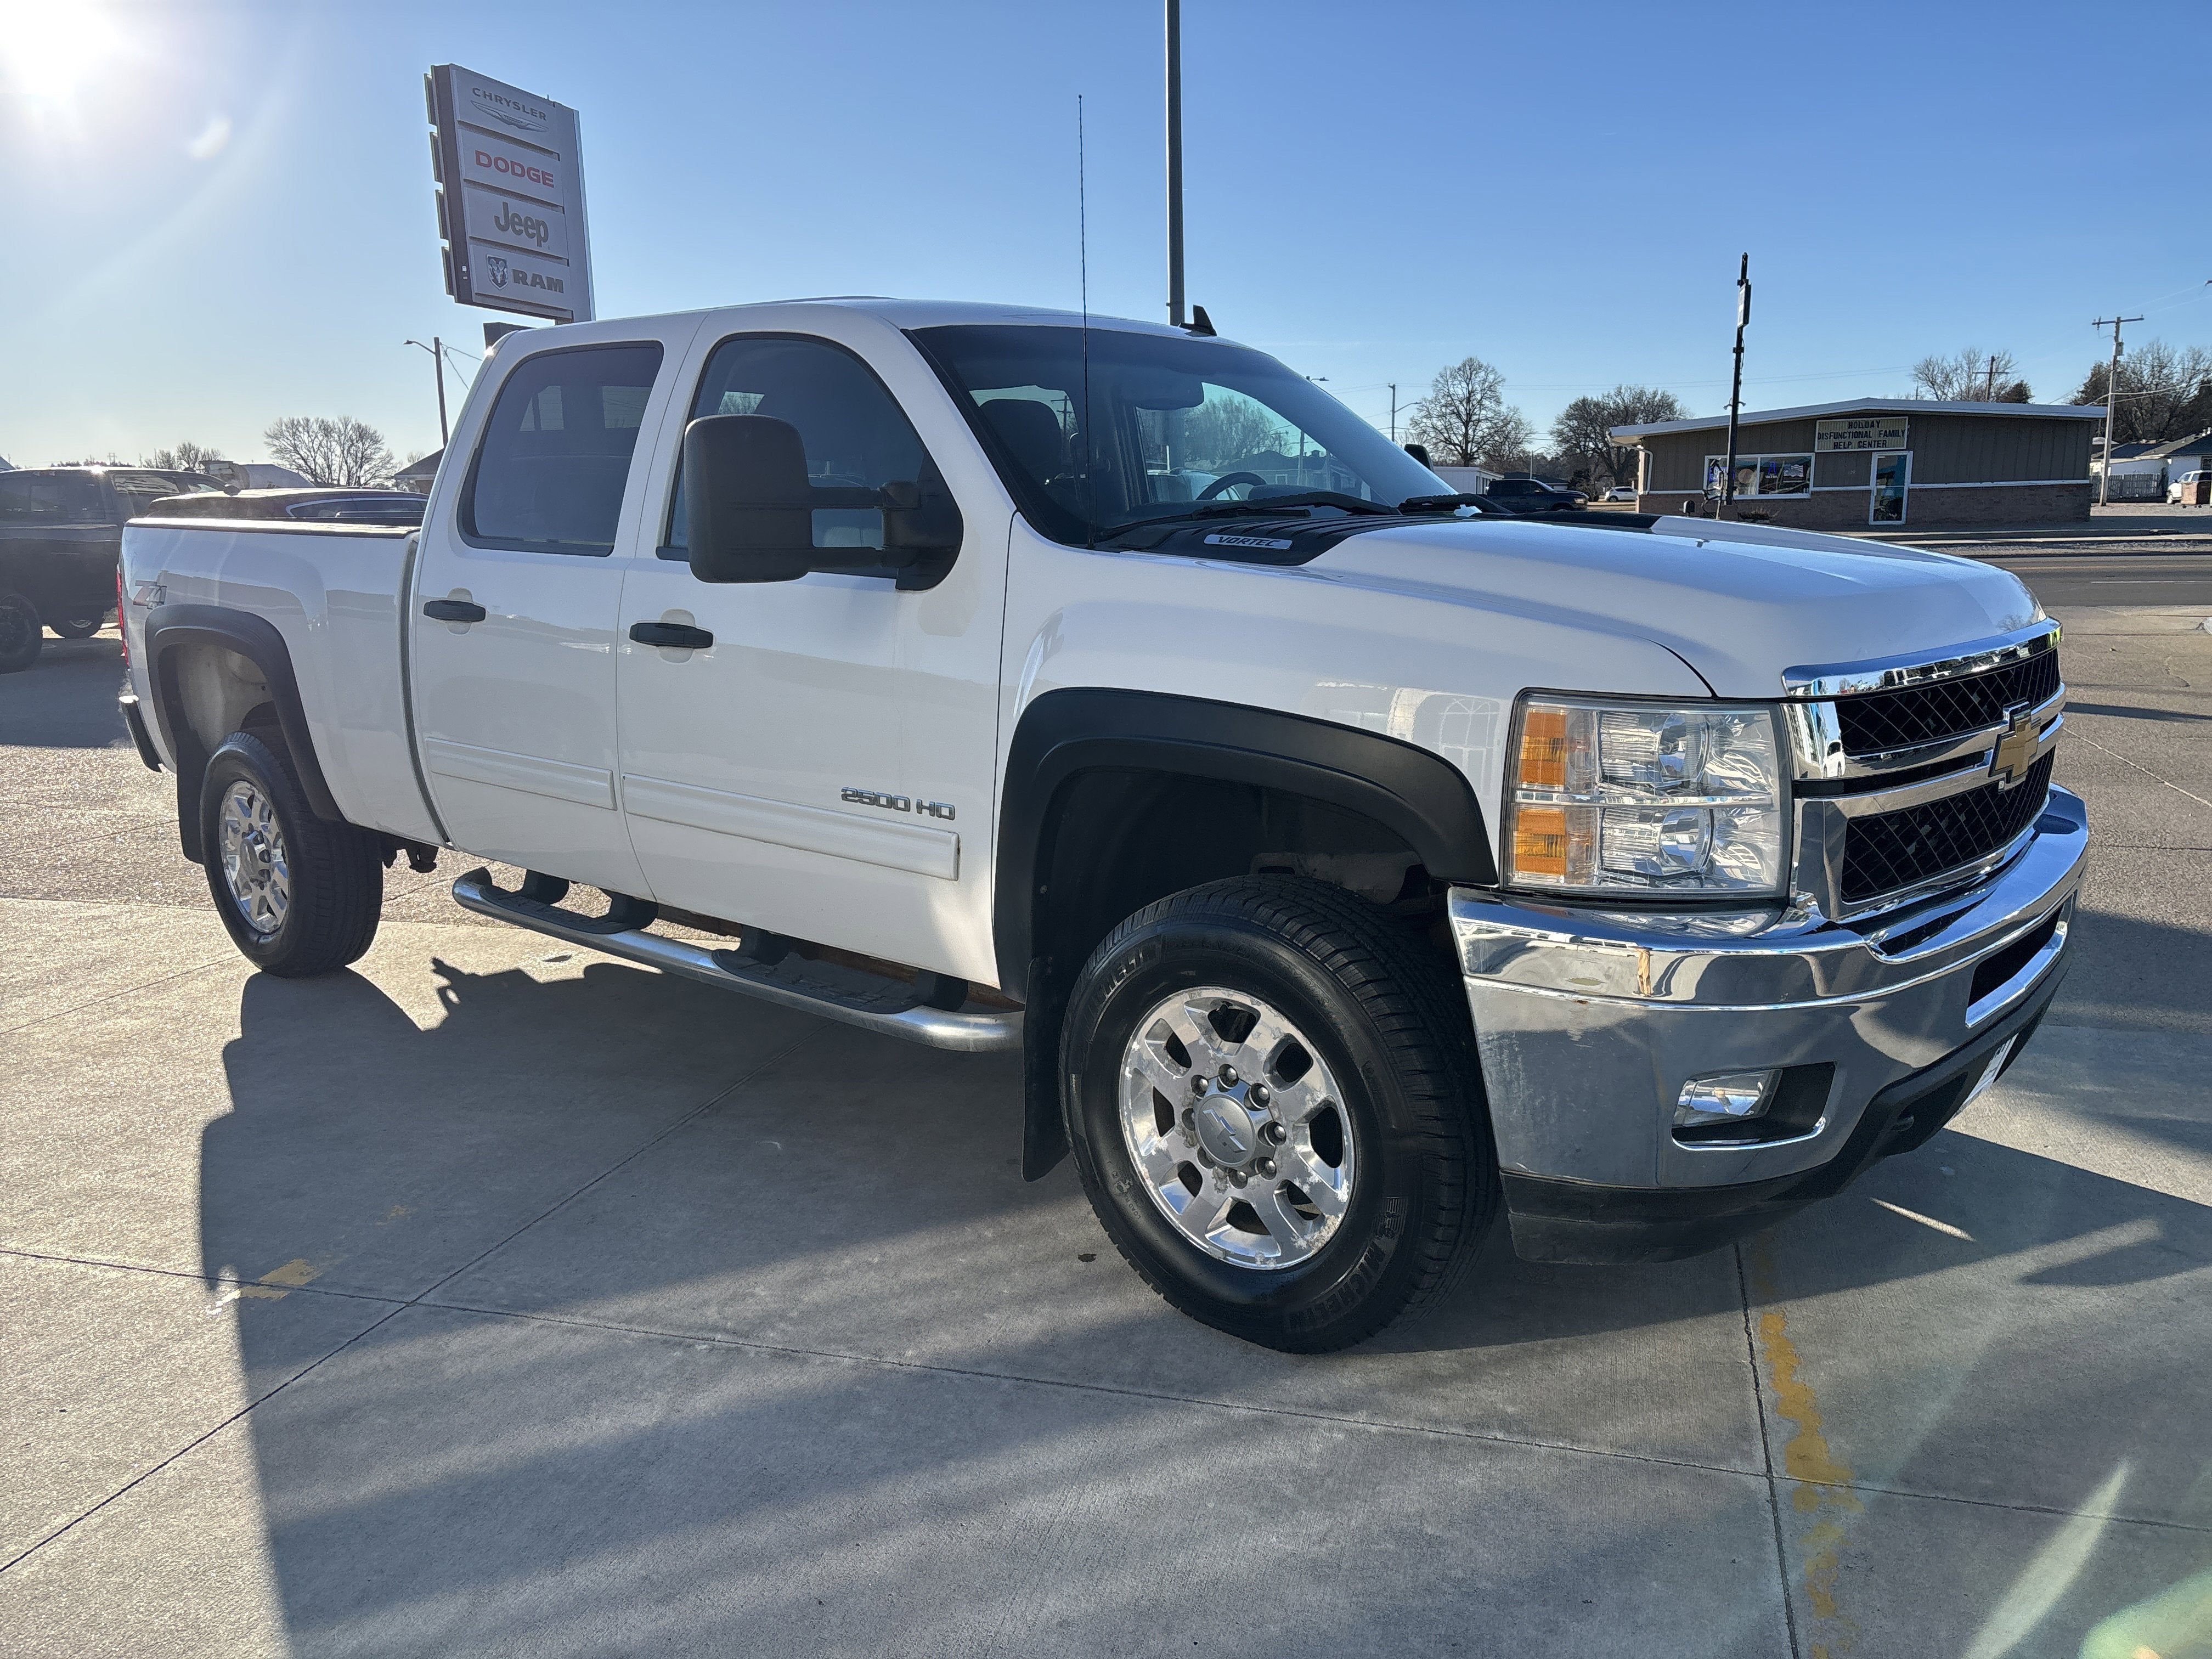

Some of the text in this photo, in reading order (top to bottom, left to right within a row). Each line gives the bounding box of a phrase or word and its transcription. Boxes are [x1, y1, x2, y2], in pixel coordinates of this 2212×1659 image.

[472, 87, 546, 121] CHRYSLER
[475, 150, 554, 188] DODGE
[494, 201, 549, 247] Jeep
[511, 269, 564, 294] RAM
[1818, 428, 1906, 440] DISFUNCTIONAL FAMILY
[1833, 439, 1887, 449] HELP CENTER
[1218, 536, 1281, 546] VORTEC
[841, 787, 955, 821] 2500 HD
